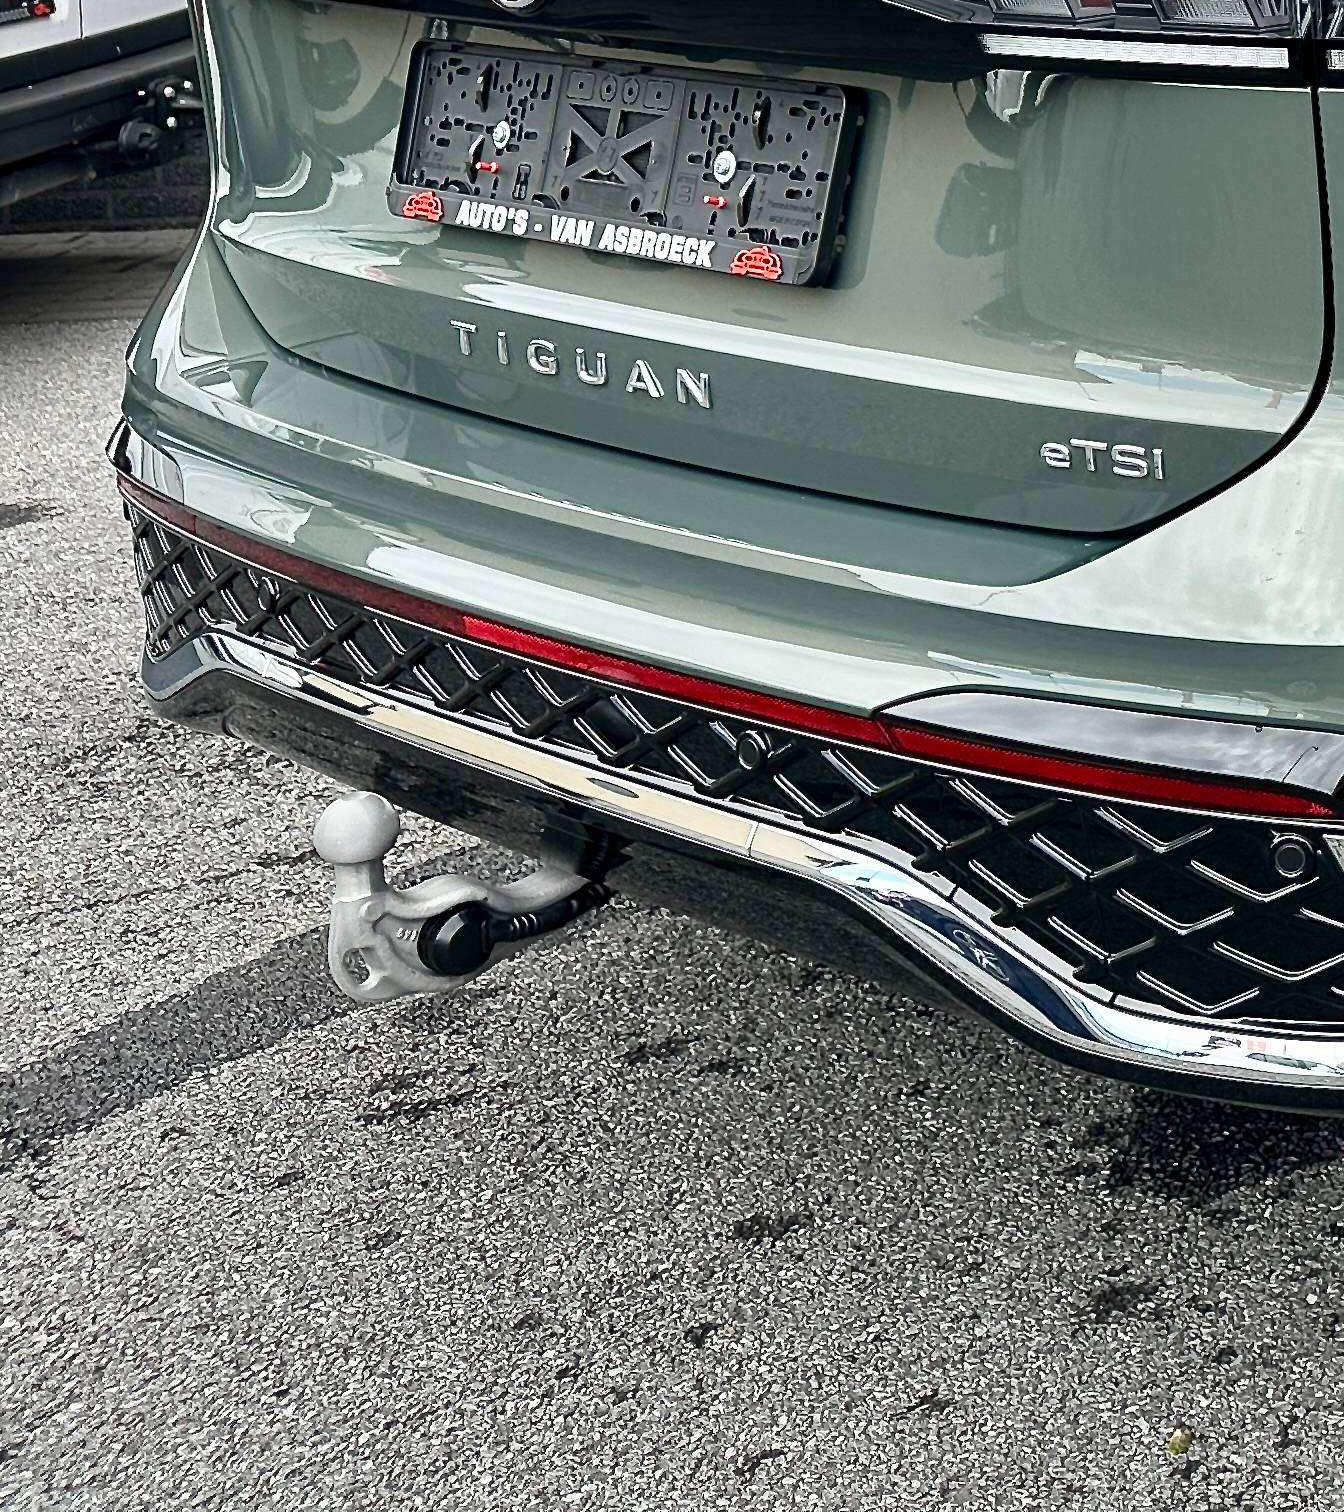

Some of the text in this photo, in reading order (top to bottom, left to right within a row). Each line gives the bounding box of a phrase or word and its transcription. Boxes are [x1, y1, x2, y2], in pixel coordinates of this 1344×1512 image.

[455, 199, 530, 236] AUTO'S
[550, 214, 595, 247] VAN
[598, 223, 716, 268] ASBROECK
[449, 319, 713, 409] TIGUAN
[1039, 437, 1165, 481] eTSI
